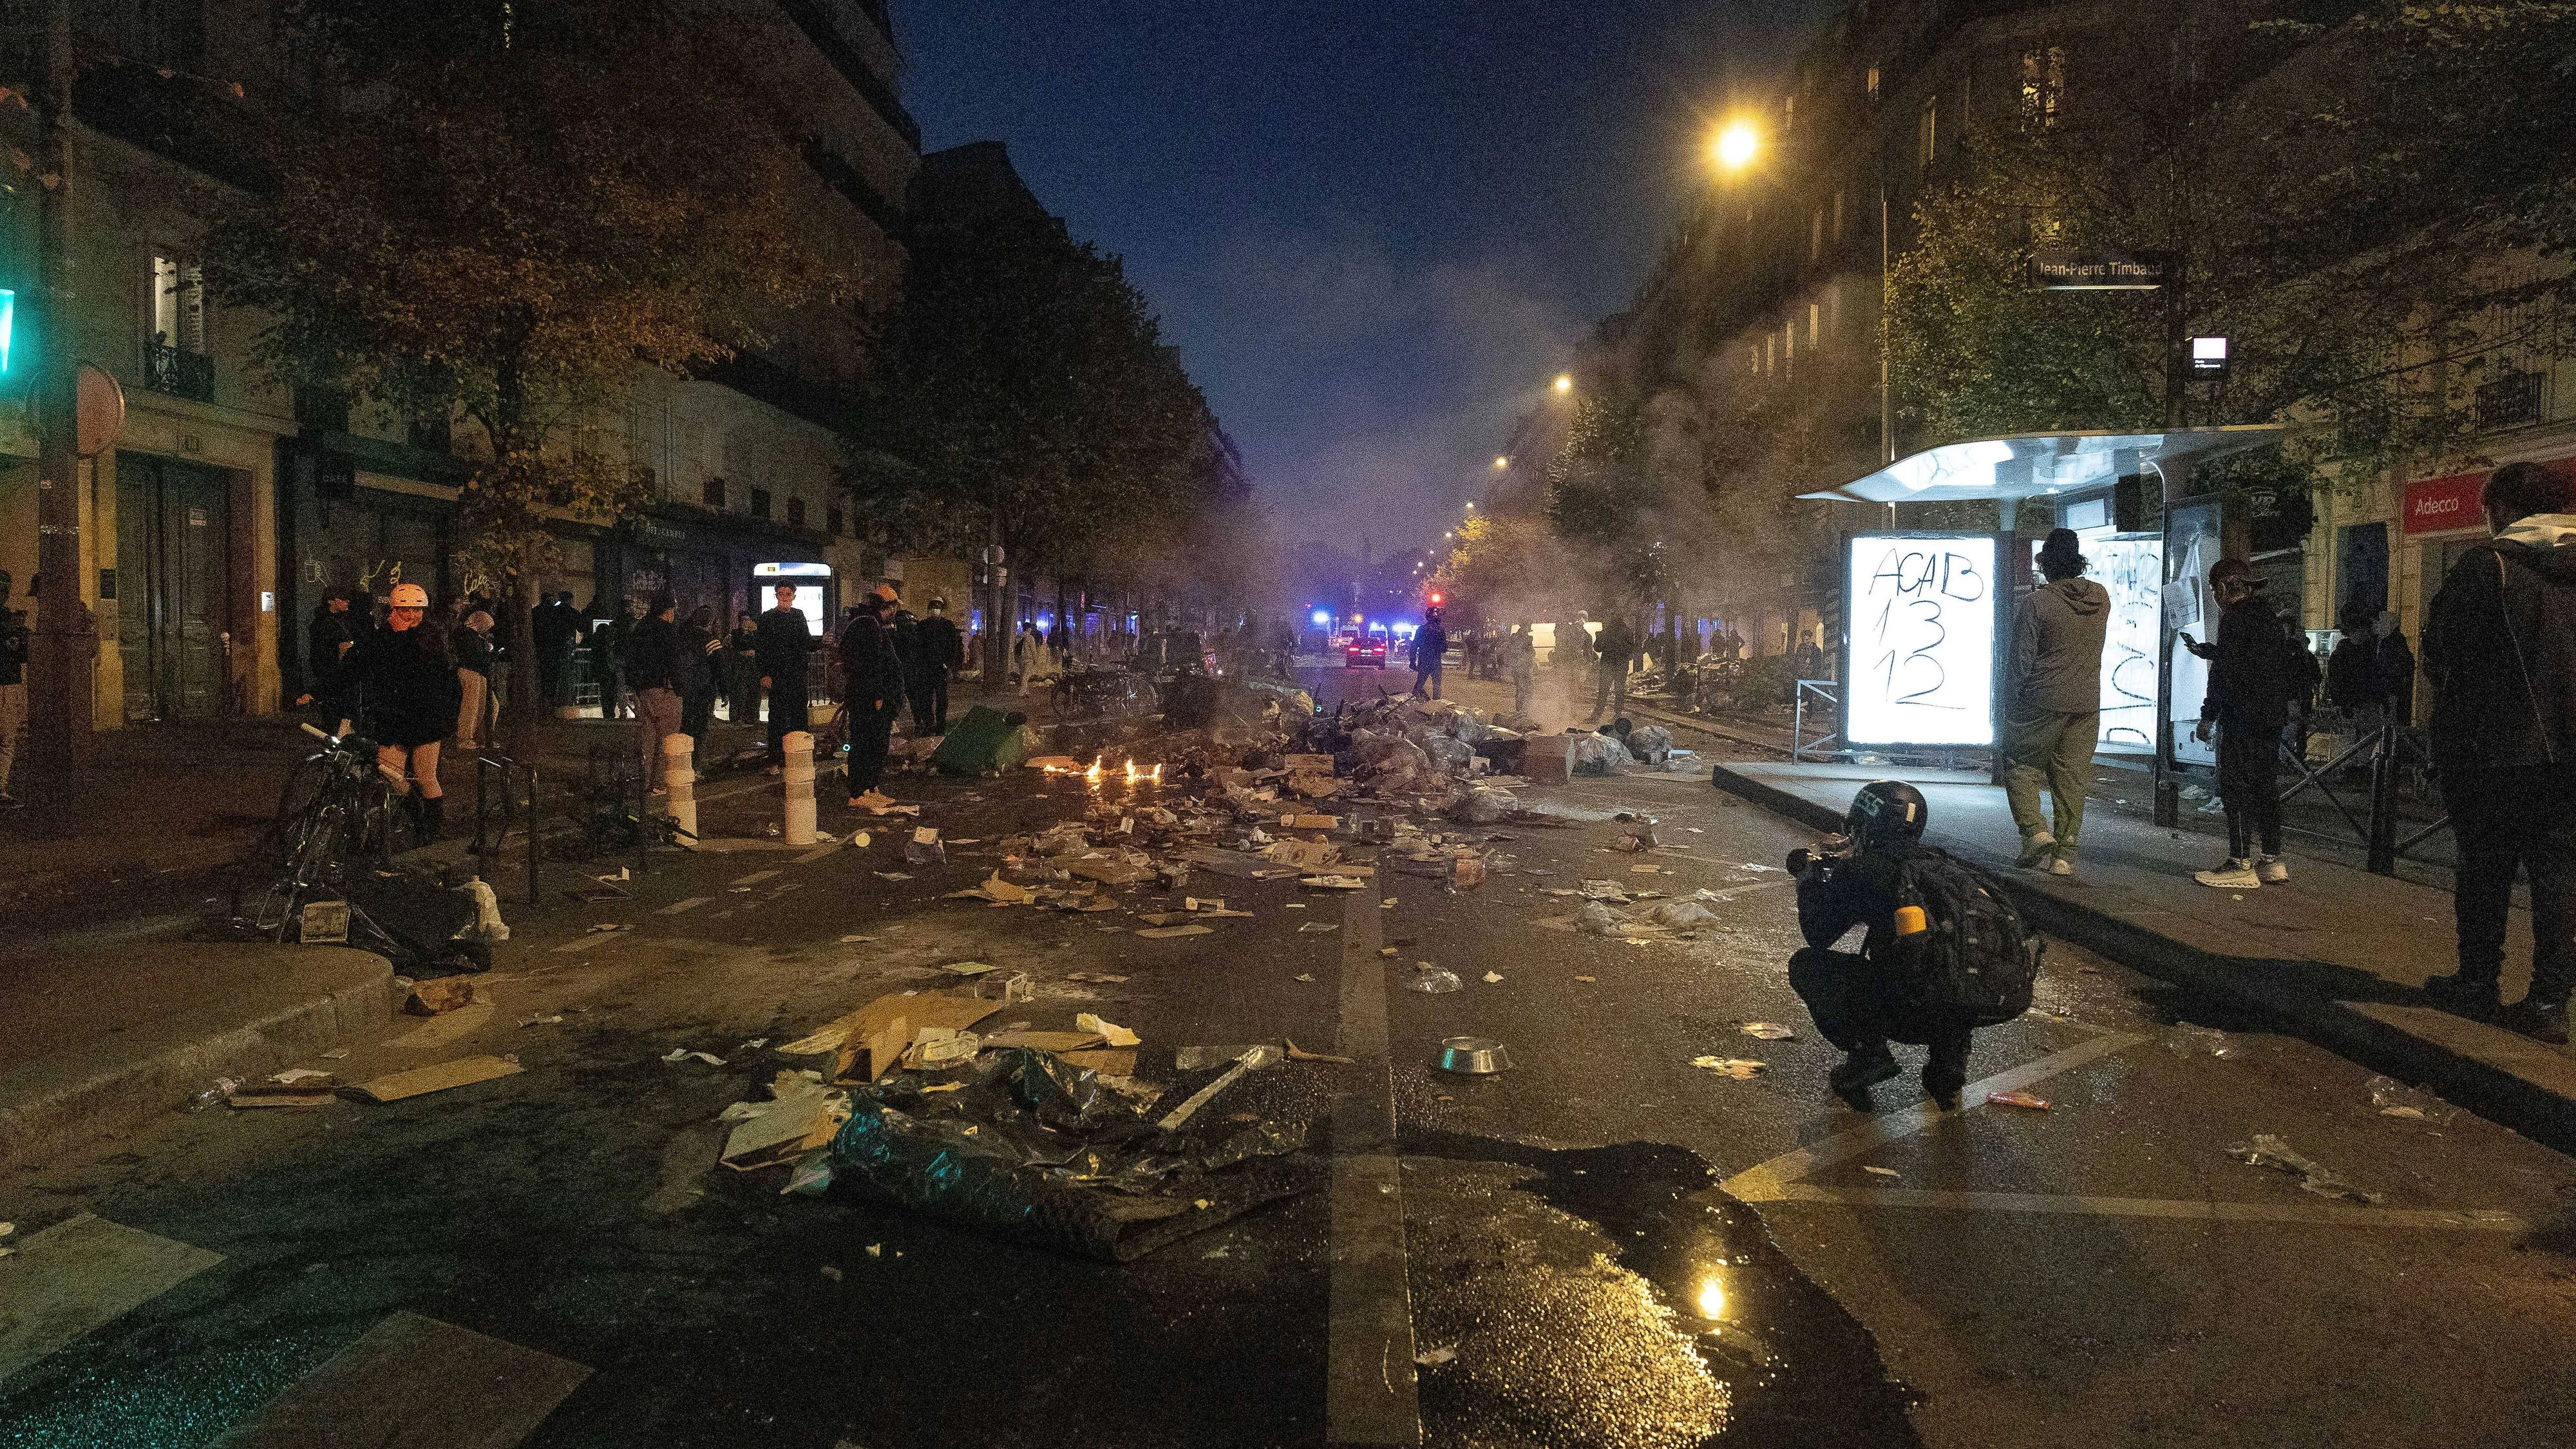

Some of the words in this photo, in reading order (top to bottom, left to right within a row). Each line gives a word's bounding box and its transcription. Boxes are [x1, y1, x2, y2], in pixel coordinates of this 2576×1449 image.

[2040, 261, 2106, 276] Jean-Pierre
[2109, 261, 2163, 276] Timbaud
[2416, 496, 2459, 516] Adecco
[1868, 547, 1984, 602] ACAB
